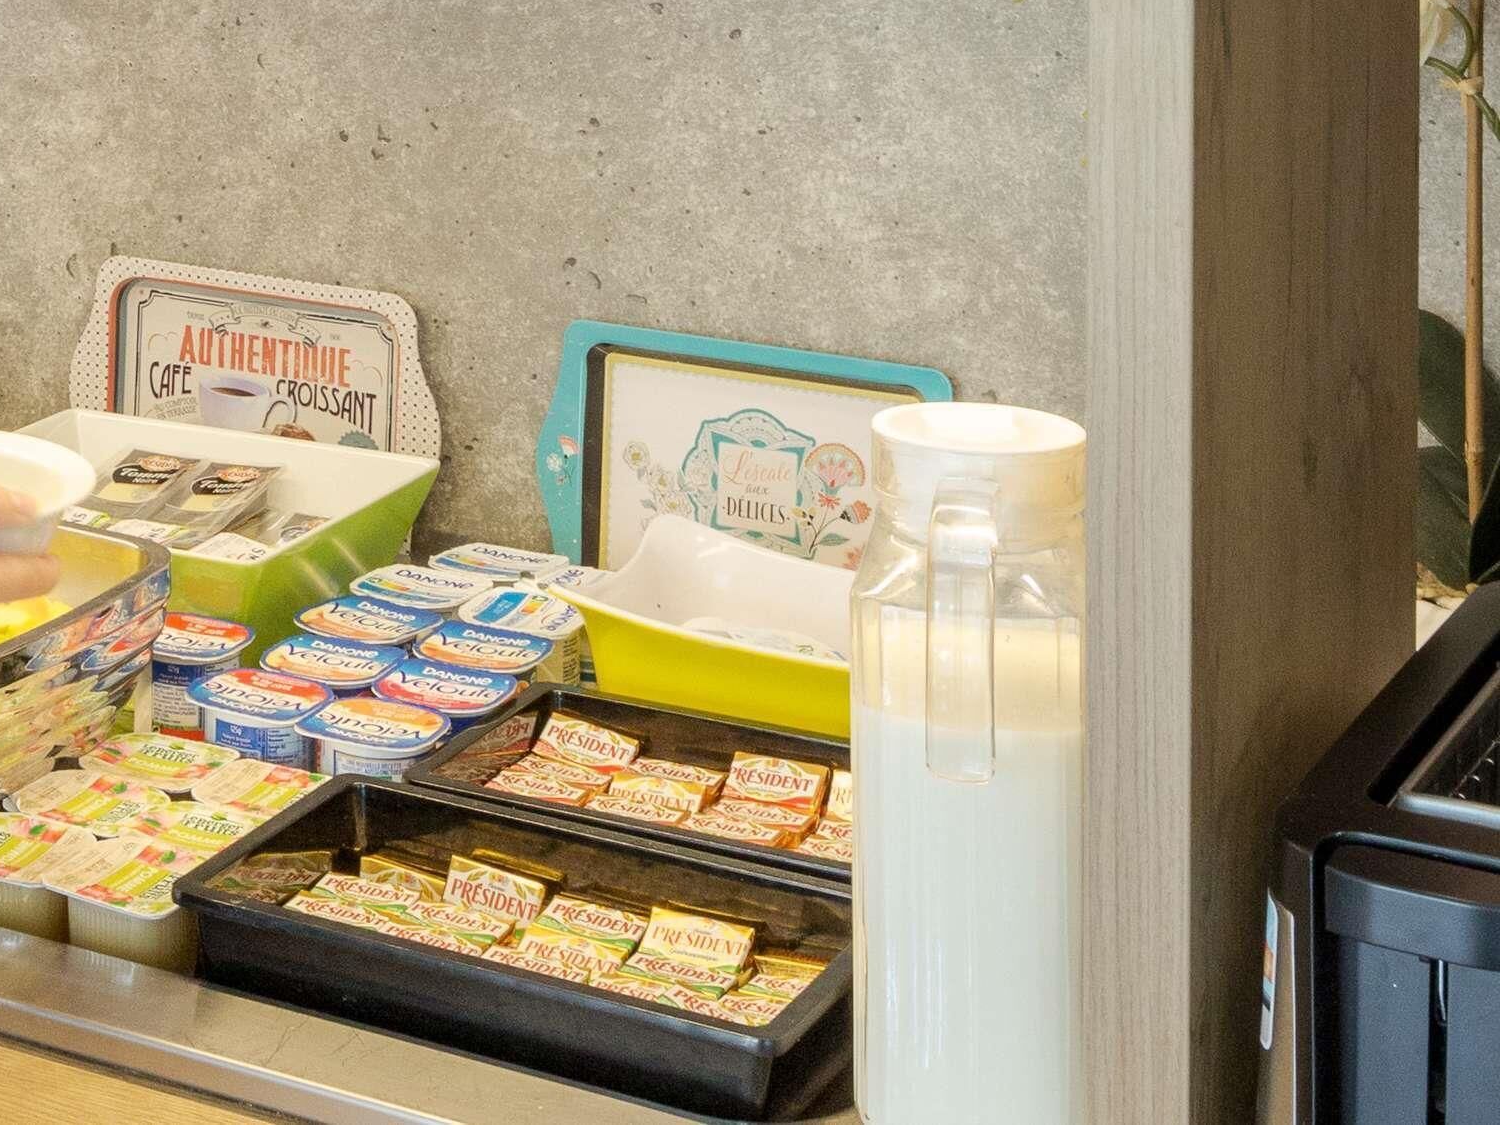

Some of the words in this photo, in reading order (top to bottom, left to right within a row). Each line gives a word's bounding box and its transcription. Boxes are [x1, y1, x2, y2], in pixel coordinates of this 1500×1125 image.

[178, 324, 352, 389] AUTHENTIQUE
[149, 360, 193, 399] CAFÉ
[276, 378, 378, 435] CROISSANT
[726, 495, 786, 525] DÉLICES
[395, 569, 475, 590] DANONE
[357, 601, 417, 623] DANONE
[310, 639, 379, 659] DANONE
[462, 629, 532, 647] DANONE
[423, 666, 493, 686] DANONE
[548, 725, 630, 762] PRÉSIDENT
[731, 766, 814, 793] PRÉSIDENT
[325, 877, 415, 904] PRÉSIDENT
[451, 878, 539, 921] PRÉSIDENT
[552, 903, 645, 936] PRÉSIDENT
